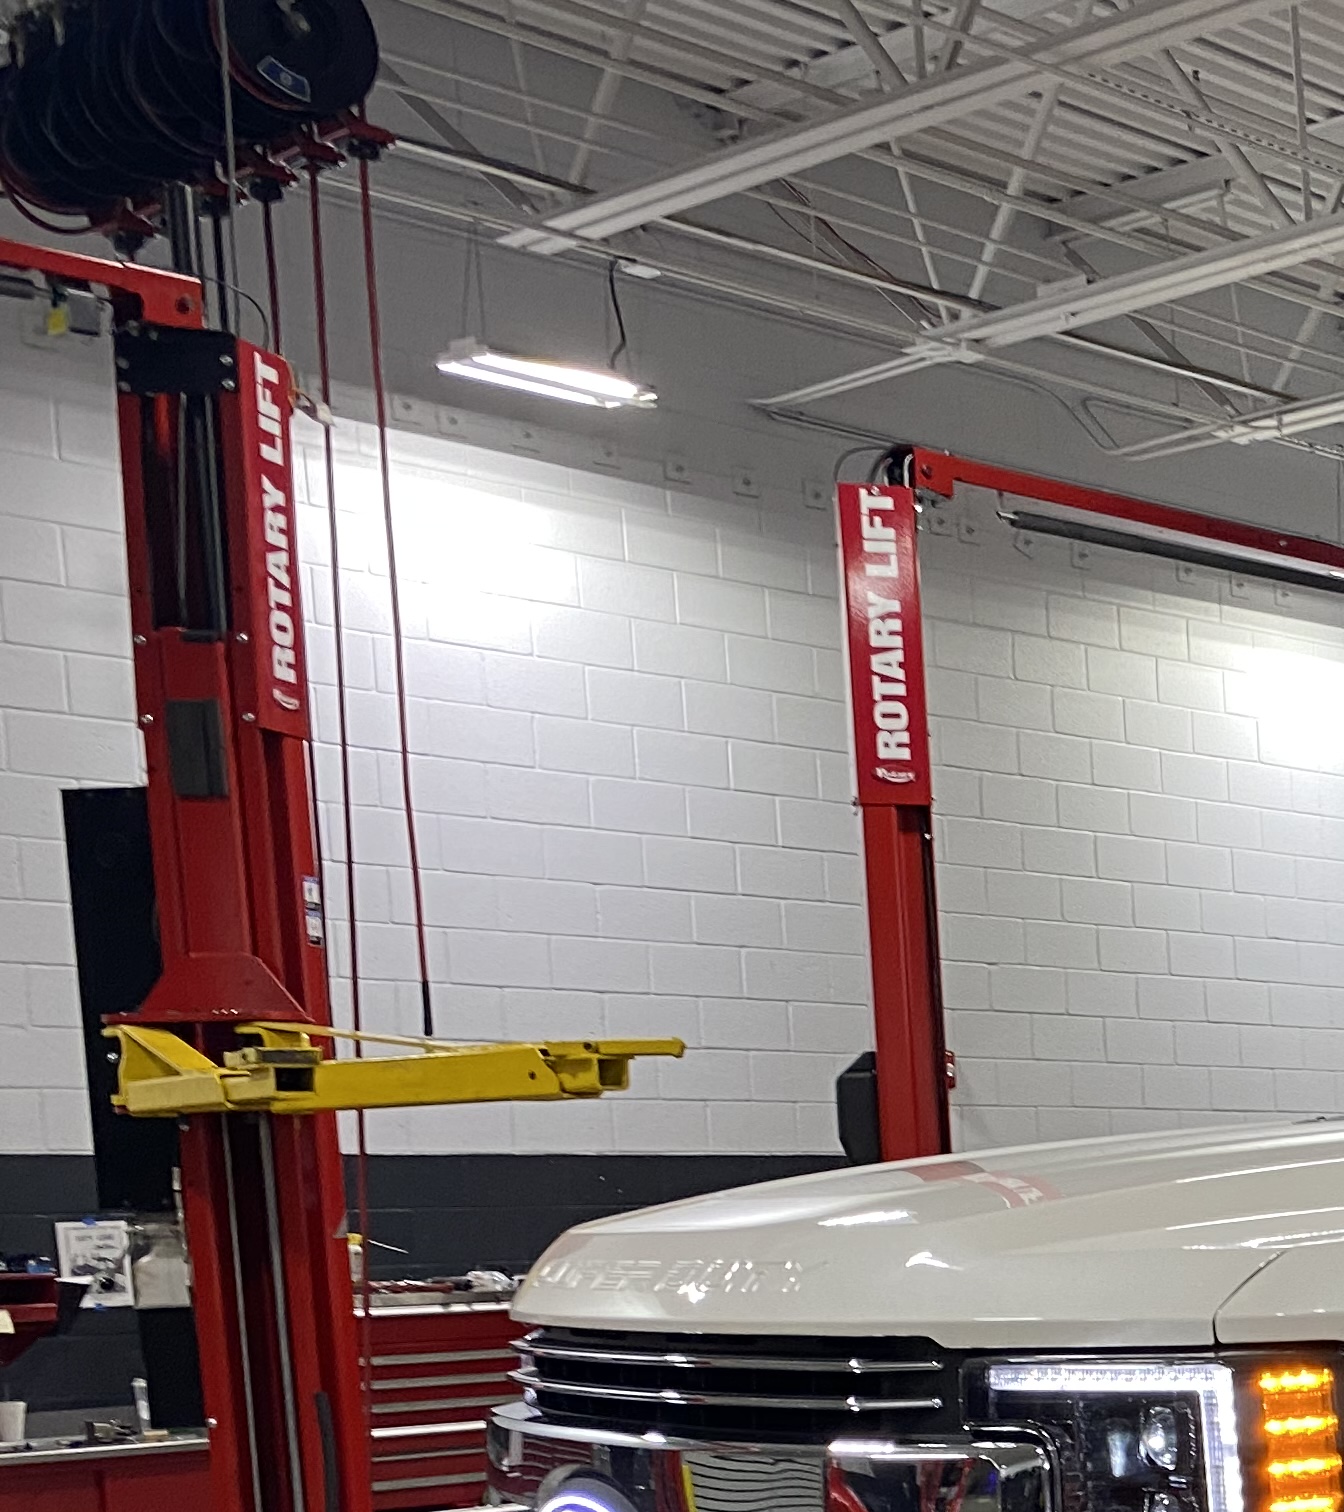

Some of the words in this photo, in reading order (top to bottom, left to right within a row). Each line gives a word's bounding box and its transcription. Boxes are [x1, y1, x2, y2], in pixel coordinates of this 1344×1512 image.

[253, 350, 285, 466] LIFT
[261, 473, 297, 684] ROTARY
[858, 487, 899, 578] LIFT
[866, 590, 912, 761] ROTARY
